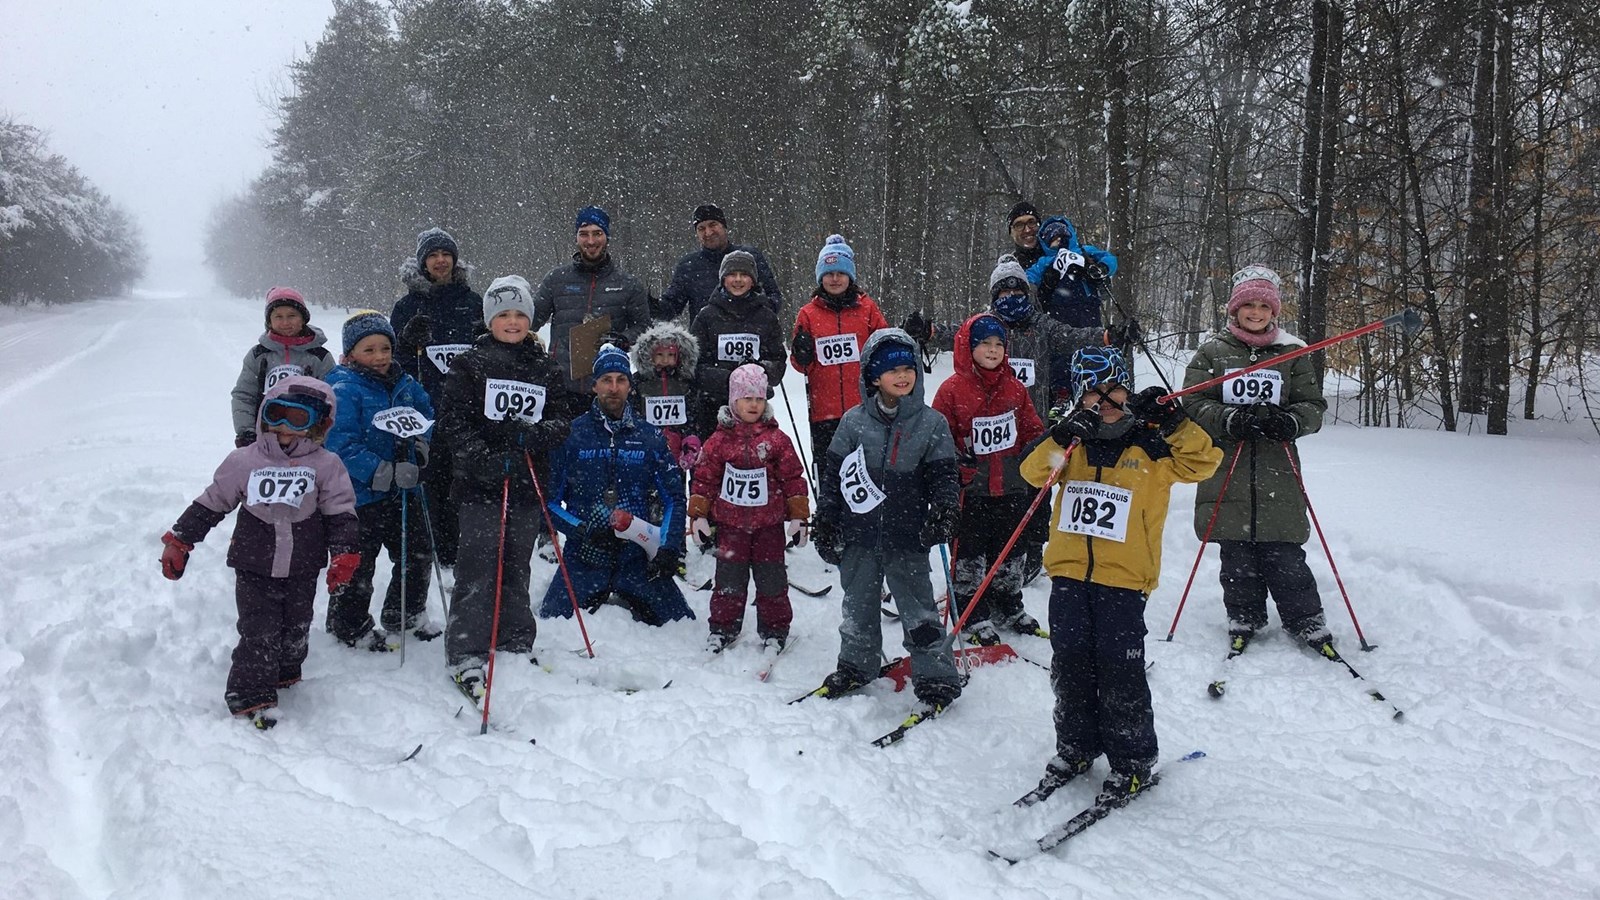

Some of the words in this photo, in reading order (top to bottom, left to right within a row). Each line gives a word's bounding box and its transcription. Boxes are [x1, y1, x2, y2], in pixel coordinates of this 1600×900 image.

[1056, 252, 1078, 271] 076
[725, 341, 754, 357] 098
[823, 342, 853, 360] 095
[888, 351, 900, 360] SKI
[510, 385, 544, 396] SAINT-LOUIS
[1232, 378, 1274, 400] 093
[495, 391, 537, 417] 092
[653, 404, 680, 420] 074
[385, 415, 424, 434] 086
[578, 449, 596, 459] SKI
[1121, 459, 1139, 469] HH
[253, 470, 276, 478] COUPE
[735, 472, 765, 480] SAINT-LOUIS
[845, 461, 868, 504] 079
[258, 477, 308, 499] 073
[726, 476, 760, 499] 075
[1084, 486, 1129, 503] SAINT-LOUIS
[1071, 496, 1117, 530] 082
[1126, 648, 1143, 660] HH
